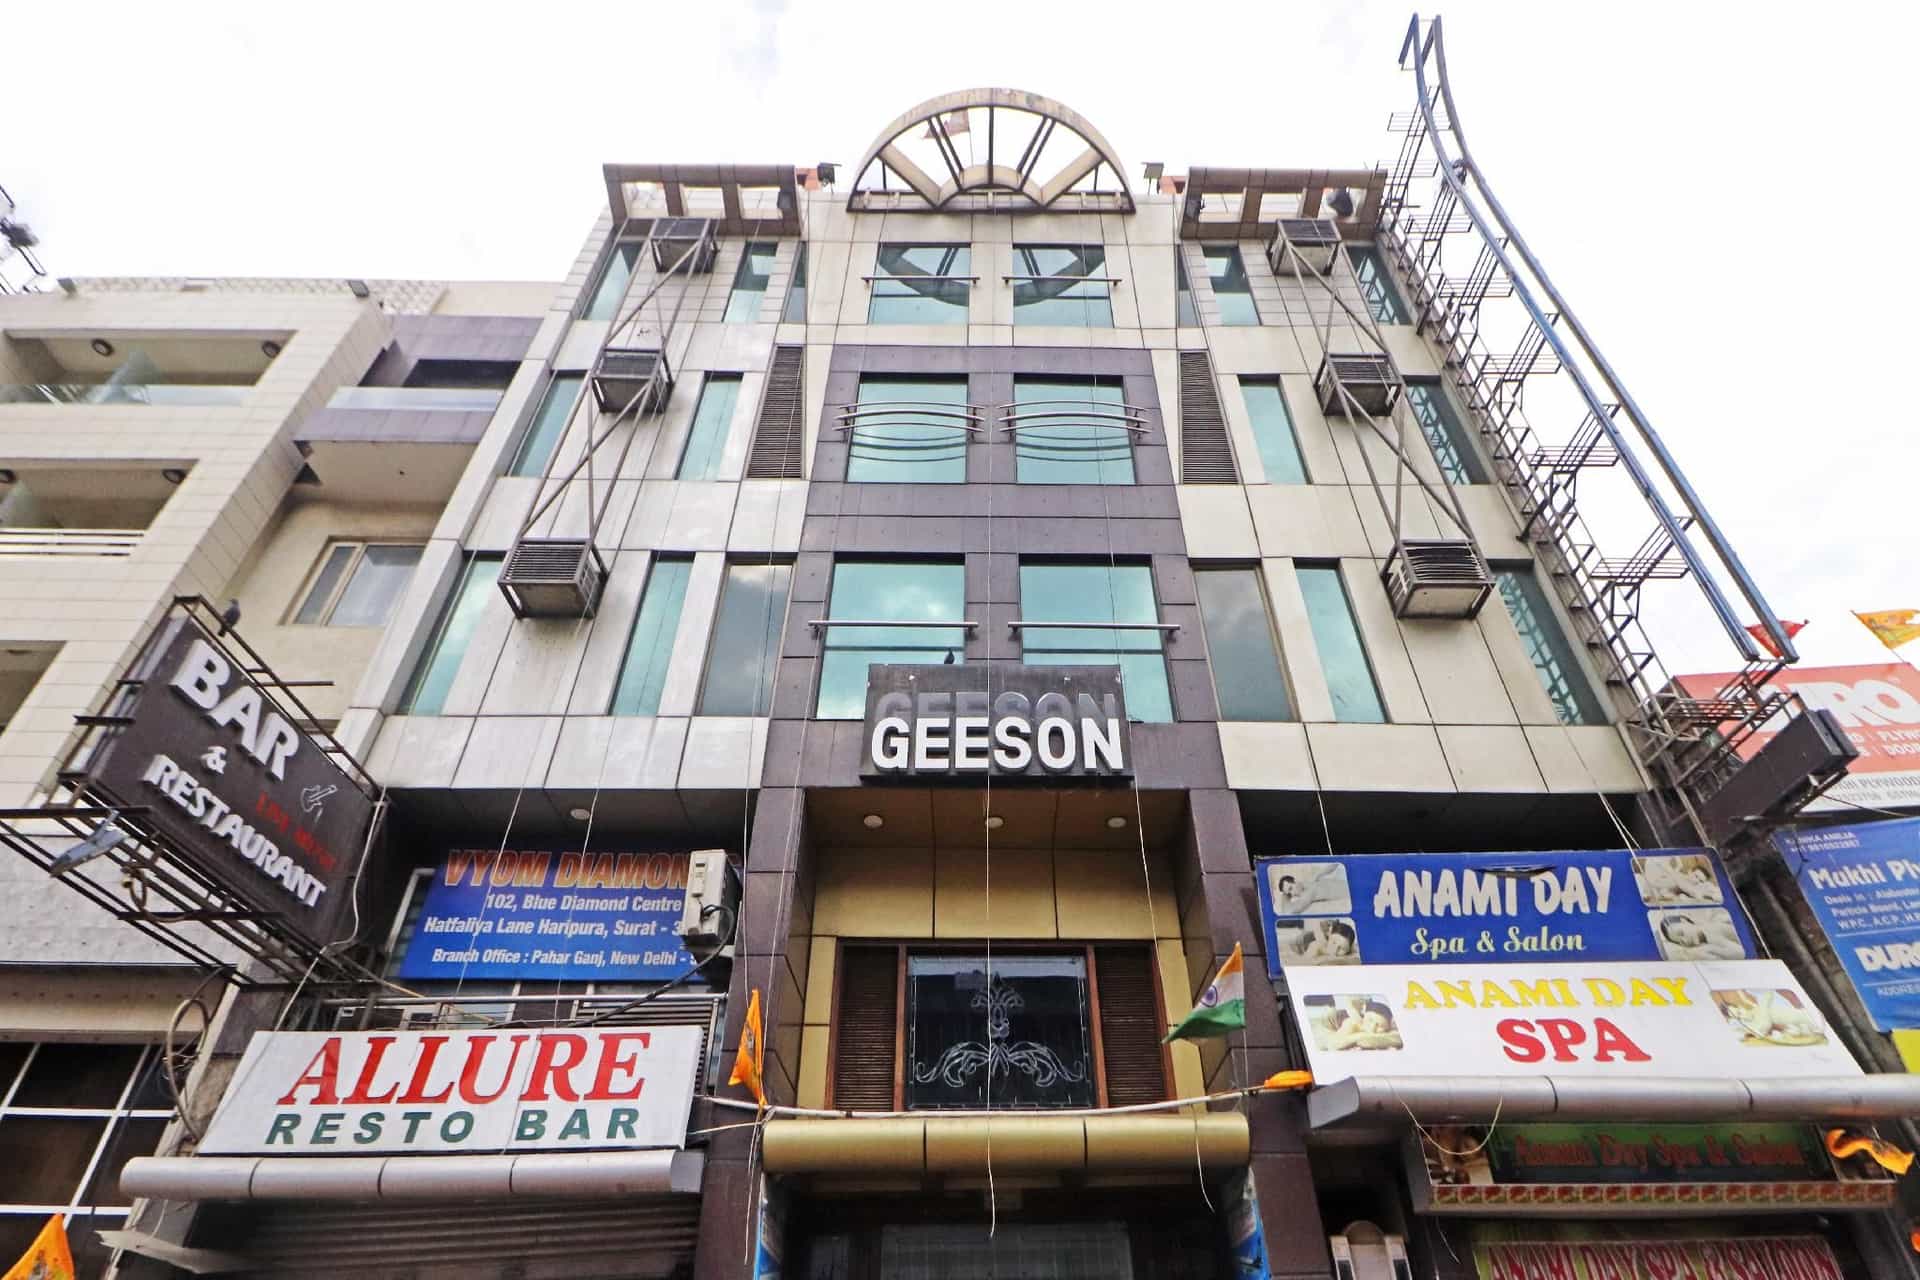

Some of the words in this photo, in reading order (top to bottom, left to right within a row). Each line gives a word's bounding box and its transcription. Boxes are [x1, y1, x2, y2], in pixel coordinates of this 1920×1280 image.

[170, 638, 299, 782] BAR
[202, 746, 227, 774] &
[871, 716, 1124, 772] GEESON
[142, 754, 328, 908] RESTAURANT
[445, 850, 552, 888] VYOM
[554, 851, 689, 889] DIAMON
[1808, 862, 1888, 889] Mukhi
[486, 893, 518, 912] 102,
[522, 894, 557, 910] Blue
[560, 895, 629, 911] Diamond
[632, 896, 682, 911] Centre
[1374, 868, 1518, 918] ANAMI
[1530, 866, 1612, 915] DAY
[496, 918, 535, 934] Lane
[537, 918, 608, 938] Haripura,
[613, 920, 657, 936] Surat
[1410, 927, 1467, 960] Spa
[1476, 930, 1495, 952] &
[1503, 926, 1586, 952] Salon
[432, 948, 479, 963] Branch
[482, 949, 520, 963] Office
[531, 949, 571, 964] Pahar
[573, 951, 605, 968] Ganj,
[610, 951, 641, 965] New
[643, 951, 678, 965] Delhi
[1403, 978, 1580, 1009] ANAMI
[1582, 977, 1693, 1008] DAY
[1496, 1017, 1652, 1063] SPA
[276, 1032, 652, 1105] ALLURE
[265, 1110, 475, 1145] RESTO
[516, 1107, 641, 1141] BAR
